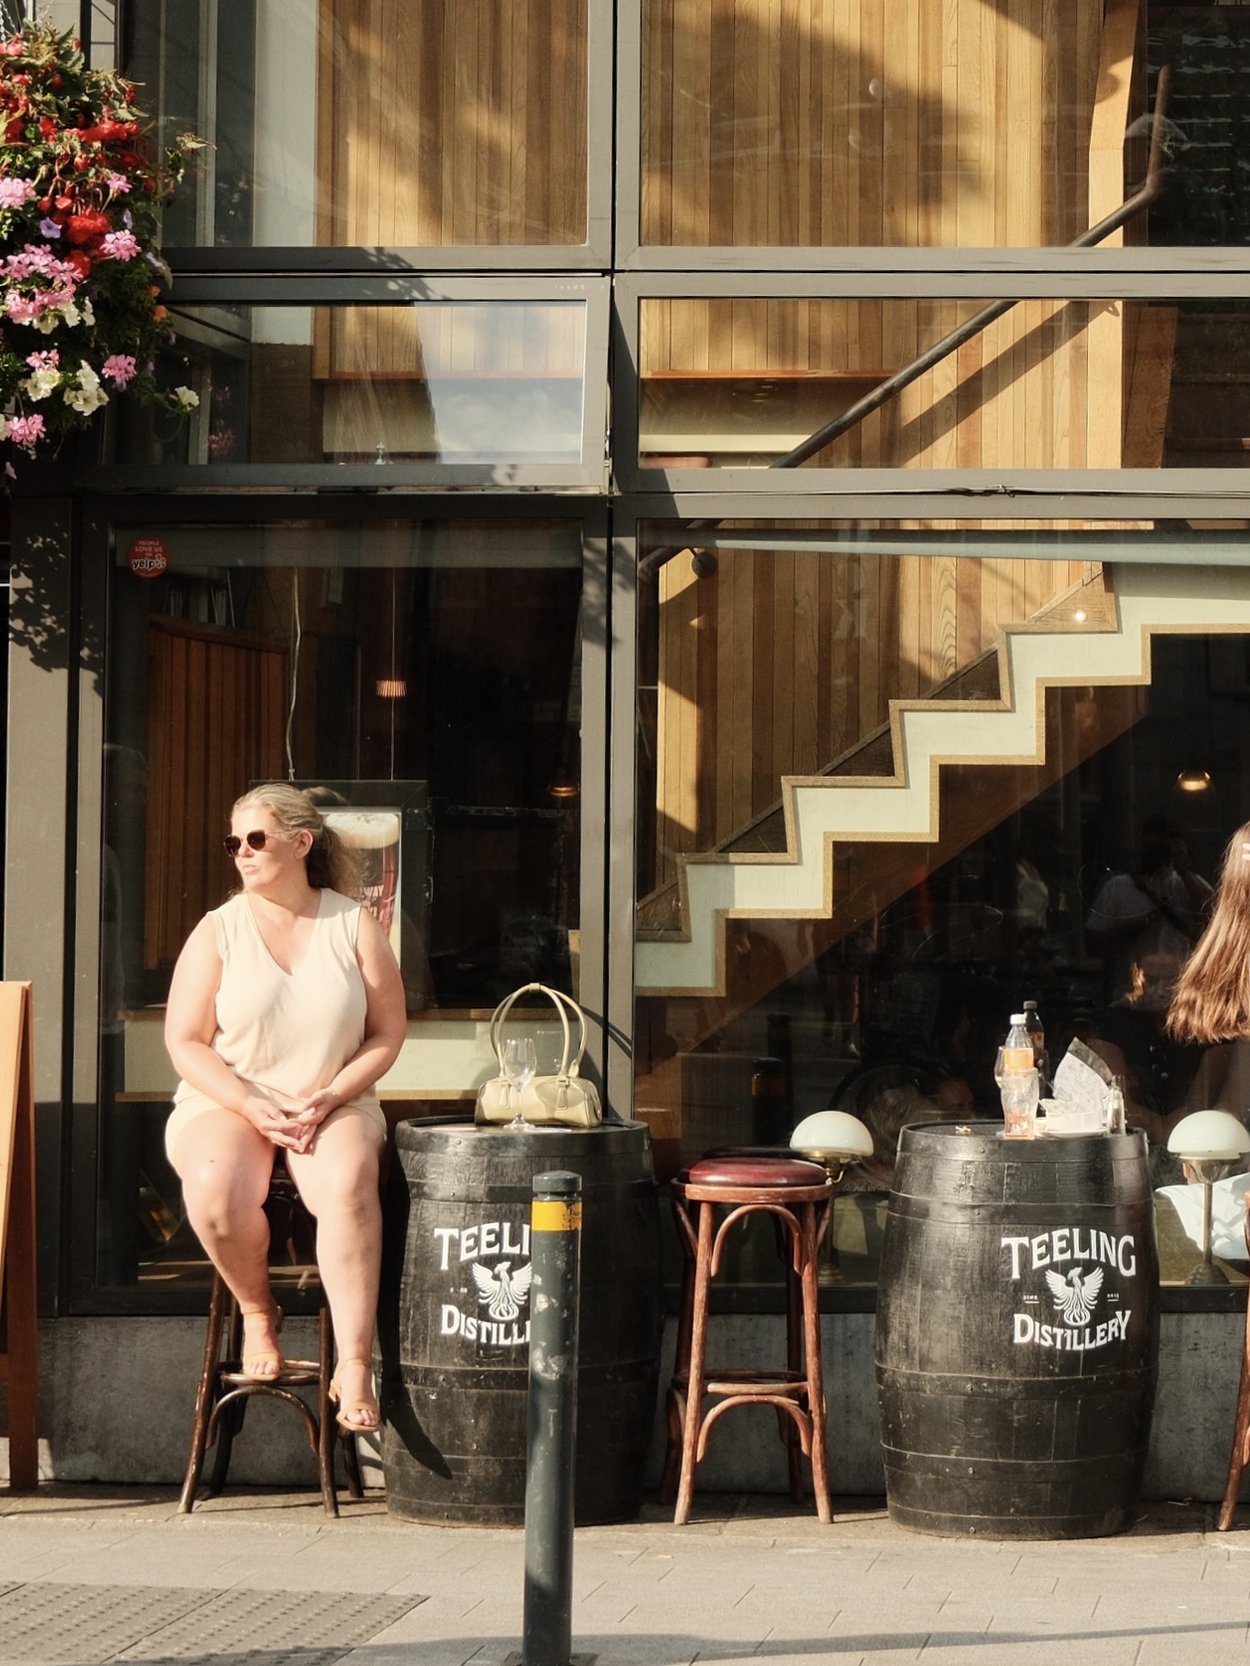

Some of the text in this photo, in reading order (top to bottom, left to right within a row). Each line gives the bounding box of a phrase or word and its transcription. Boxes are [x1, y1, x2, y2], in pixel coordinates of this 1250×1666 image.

[132, 558, 155, 570] yelp
[362, 884, 385, 898] WAY
[434, 1222, 531, 1271] TEELI
[1001, 1228, 1136, 1279] TEELING
[441, 1304, 531, 1345] DISTILL
[1013, 1310, 1132, 1350] DISTILLERY
